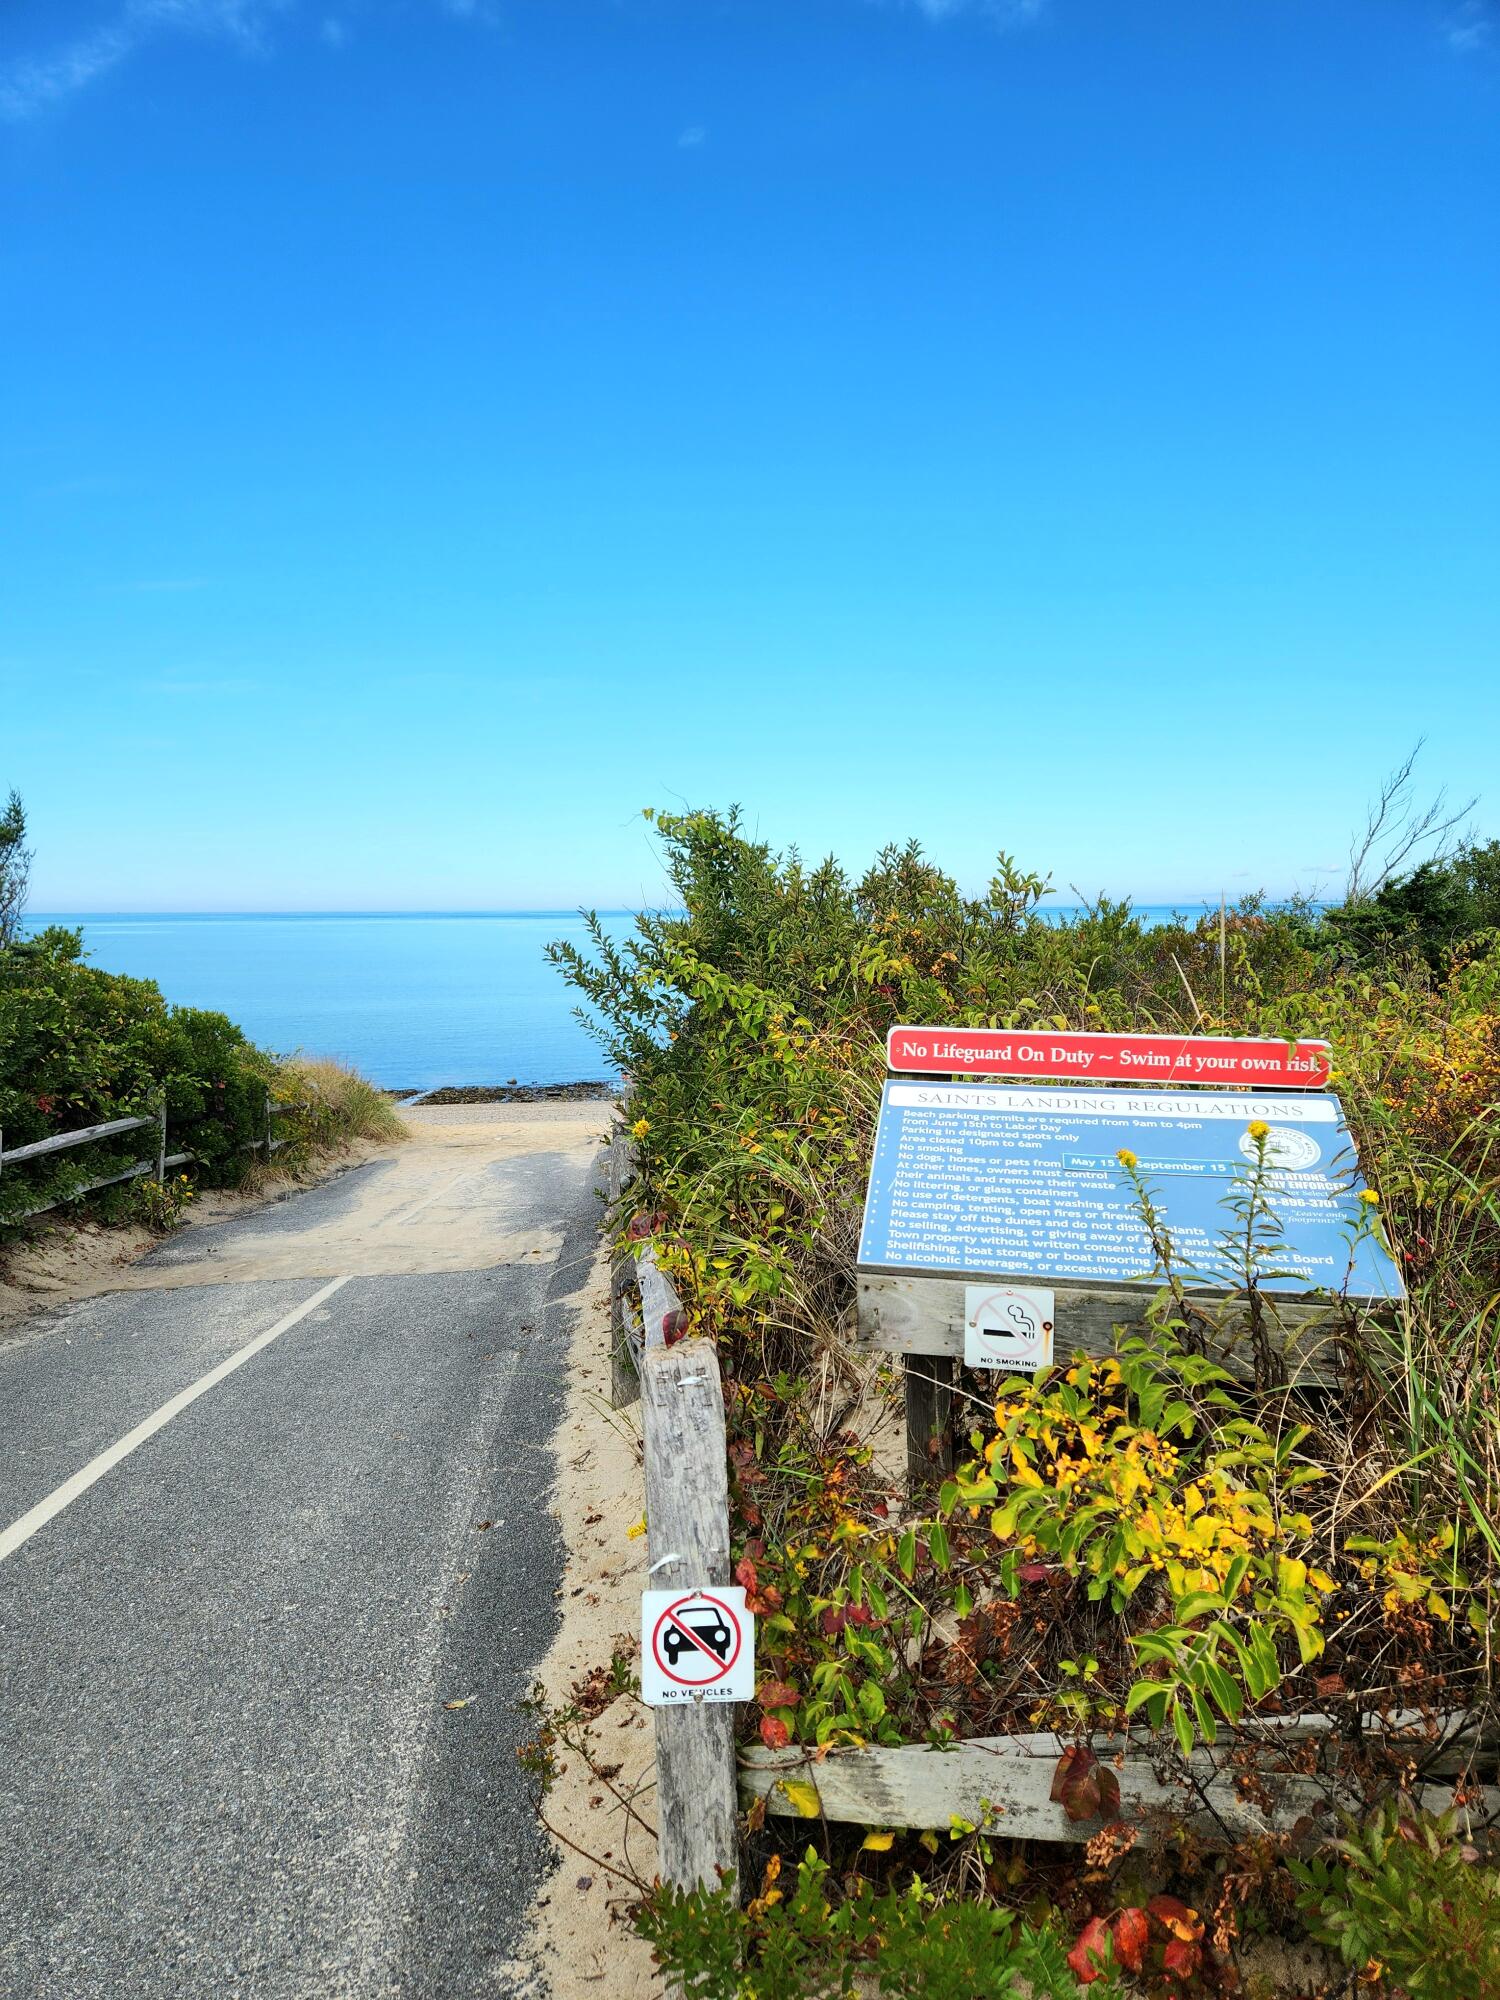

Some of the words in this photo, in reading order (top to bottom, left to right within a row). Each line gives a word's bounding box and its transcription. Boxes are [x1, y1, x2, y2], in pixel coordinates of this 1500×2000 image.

[902, 1042, 927, 1057] No
[933, 1043, 1011, 1063] Lifeguard
[1018, 1046, 1045, 1062] On
[1051, 1047, 1094, 1068] Duty
[1120, 1050, 1171, 1066] Swim
[1175, 1053, 1192, 1067] at
[1193, 1056, 1237, 1072] your
[1241, 1058, 1281, 1071] own
[1286, 1056, 1321, 1072] risk
[918, 1092, 997, 1106] SAINTS
[1008, 1096, 1116, 1111] LANDING
[1127, 1101, 1303, 1117] REGULATIONS
[903, 1109, 935, 1118] Beach
[938, 1112, 979, 1122] parking
[982, 1113, 1024, 1123] permits
[1049, 1117, 1099, 1127] required
[1101, 1118, 1129, 1126] from
[1132, 1119, 1157, 1128] 9am
[1161, 1120, 1173, 1128] to
[1176, 1121, 1202, 1130] 4pm
[903, 1117, 928, 1126] from
[931, 1119, 958, 1127] June
[963, 1120, 987, 1129] 15th
[1005, 1122, 1037, 1131] Labor
[1041, 1124, 1061, 1133] Day
[900, 1135, 926, 1143] Area
[929, 1136, 964, 1144] closed
[969, 1138, 999, 1147] 10pm
[1018, 1140, 1042, 1149] 6am
[902, 1126, 942, 1136] Parking
[959, 1128, 1019, 1139] designated
[1022, 1132, 1052, 1141] spots
[1055, 1133, 1079, 1143] only
[899, 1143, 914, 1151] No
[917, 1144, 963, 1154] smoking
[897, 1161, 909, 1169] At
[912, 1162, 944, 1170] other
[947, 1164, 983, 1174] times,
[987, 1166, 1029, 1175] owners
[1032, 1168, 1062, 1177] must
[1065, 1171, 1108, 1180] control
[898, 1152, 913, 1160] No
[916, 1153, 945, 1163] dogs,
[949, 1155, 986, 1164] horses
[1005, 1158, 1030, 1167] pets
[1033, 1159, 1061, 1168] from
[1071, 1157, 1095, 1168] May
[1100, 1158, 1115, 1167] 15
[1136, 1161, 1205, 1172] September
[1210, 1164, 1226, 1172] 15
[894, 1180, 910, 1188] No
[914, 1181, 963, 1192] littering,
[968, 1184, 980, 1192] or
[984, 1185, 1012, 1194] glass
[1015, 1187, 1079, 1198] containers
[896, 1170, 924, 1179] their
[927, 1172, 970, 1182] animals
[974, 1175, 995, 1183] and
[1000, 1177, 1044, 1186] remove
[1048, 1178, 1079, 1187] their
[1081, 1181, 1116, 1190] waste
[892, 1199, 908, 1207] No
[911, 1201, 964, 1212] camping,
[968, 1204, 1015, 1215] tenting,
[1020, 1207, 1050, 1217] open
[1054, 1208, 1082, 1218] fires
[893, 1189, 909, 1197] No
[936, 1192, 948, 1200] of
[951, 1193, 1020, 1205] detergents,
[1023, 1197, 1051, 1206] boat
[1054, 1199, 1104, 1210] washing
[891, 1209, 929, 1219] Please
[932, 1213, 957, 1222] stay
[960, 1213, 978, 1222] off
[981, 1215, 1002, 1224] the
[1005, 1216, 1041, 1226] dunes
[1045, 1219, 1068, 1228] and
[1072, 1221, 1088, 1229] do
[1091, 1222, 1112, 1230] not
[889, 1219, 905, 1228] No
[909, 1221, 951, 1232] selling,
[955, 1224, 1027, 1237] advertising,
[1032, 1229, 1045, 1237] or
[1049, 1230, 1086, 1241] giving
[1090, 1233, 1123, 1243] away
[1127, 1234, 1140, 1243] of
[1184, 1238, 1209, 1248] and
[887, 1240, 960, 1254] Shellfishing,
[964, 1246, 993, 1256] boat
[996, 1248, 1042, 1260] storage
[1046, 1252, 1060, 1260] or
[1064, 1252, 1093, 1262] boat
[1096, 1255, 1151, 1267] mooring
[888, 1229, 919, 1239] Town
[923, 1231, 977, 1245] property
[981, 1236, 1029, 1247] without
[1032, 1240, 1080, 1250] written
[1084, 1244, 1135, 1254] consent
[1138, 1245, 1151, 1255] of
[1292, 1254, 1334, 1265] Board
[886, 1251, 902, 1260] No
[905, 1253, 960, 1264] alcoholic
[964, 1256, 1033, 1270] beverages,
[1037, 1262, 1051, 1271] or
[1055, 1263, 1118, 1275] excessive
[996, 1358, 1037, 1367] SMOKING
[663, 1690, 677, 1698] NO
